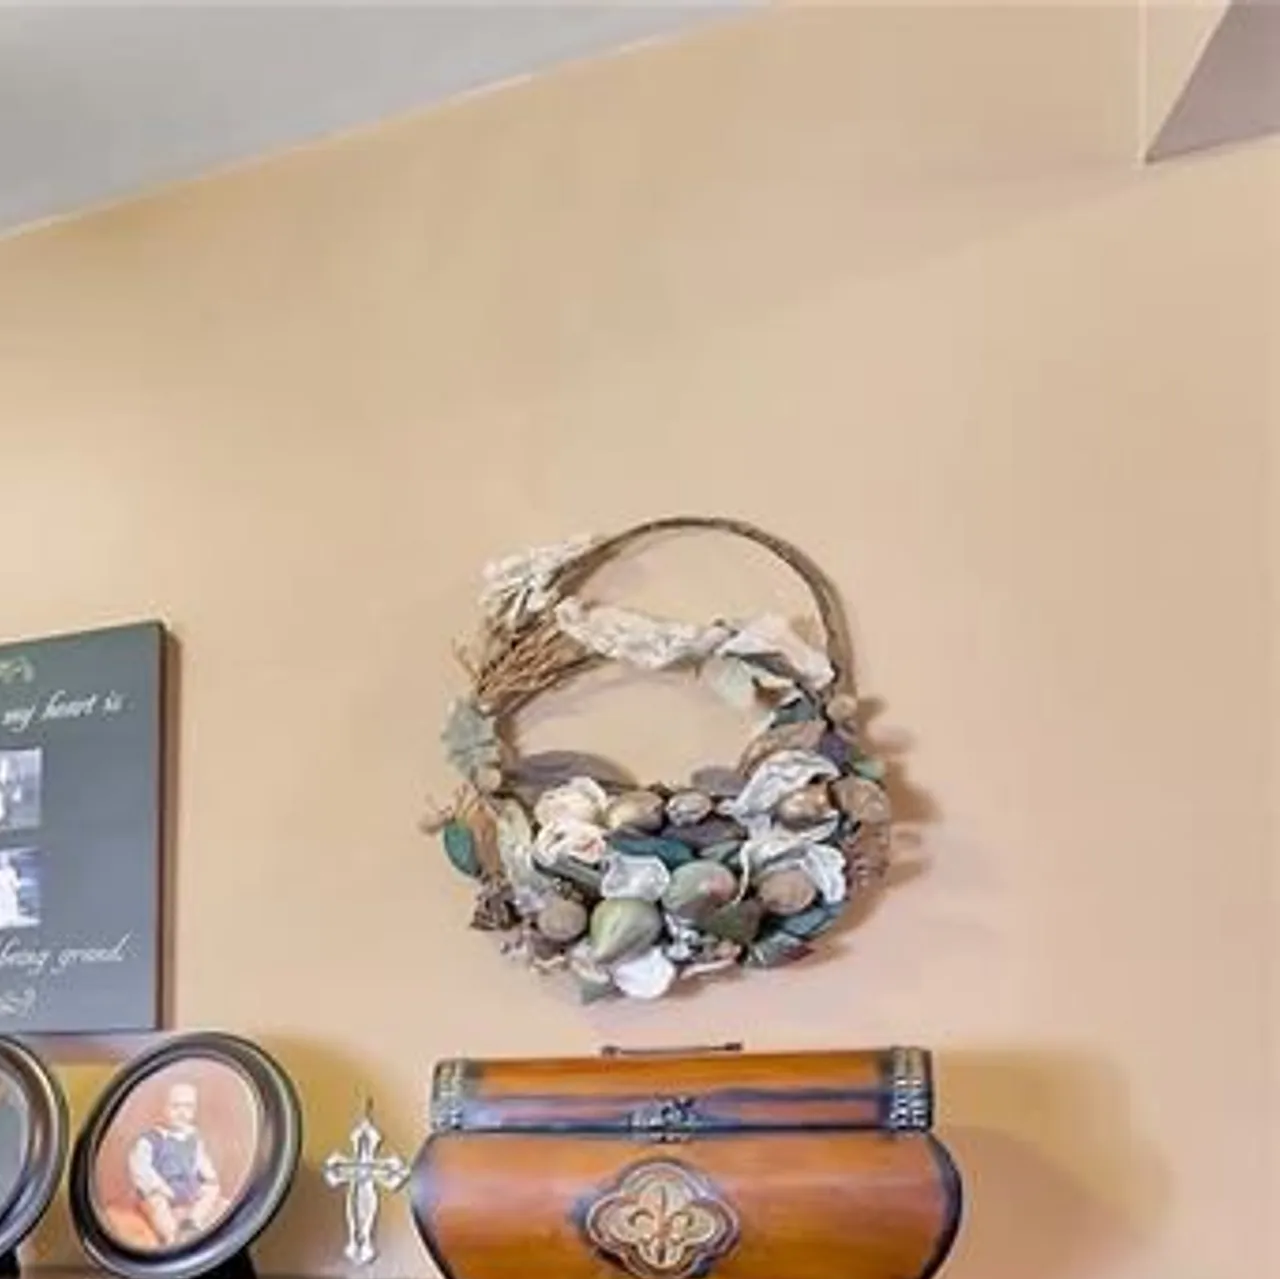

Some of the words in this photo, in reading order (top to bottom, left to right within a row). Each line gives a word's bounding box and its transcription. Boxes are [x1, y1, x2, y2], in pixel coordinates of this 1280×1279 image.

[2, 703, 39, 731] my
[41, 690, 97, 722] heart
[103, 690, 125, 714] is
